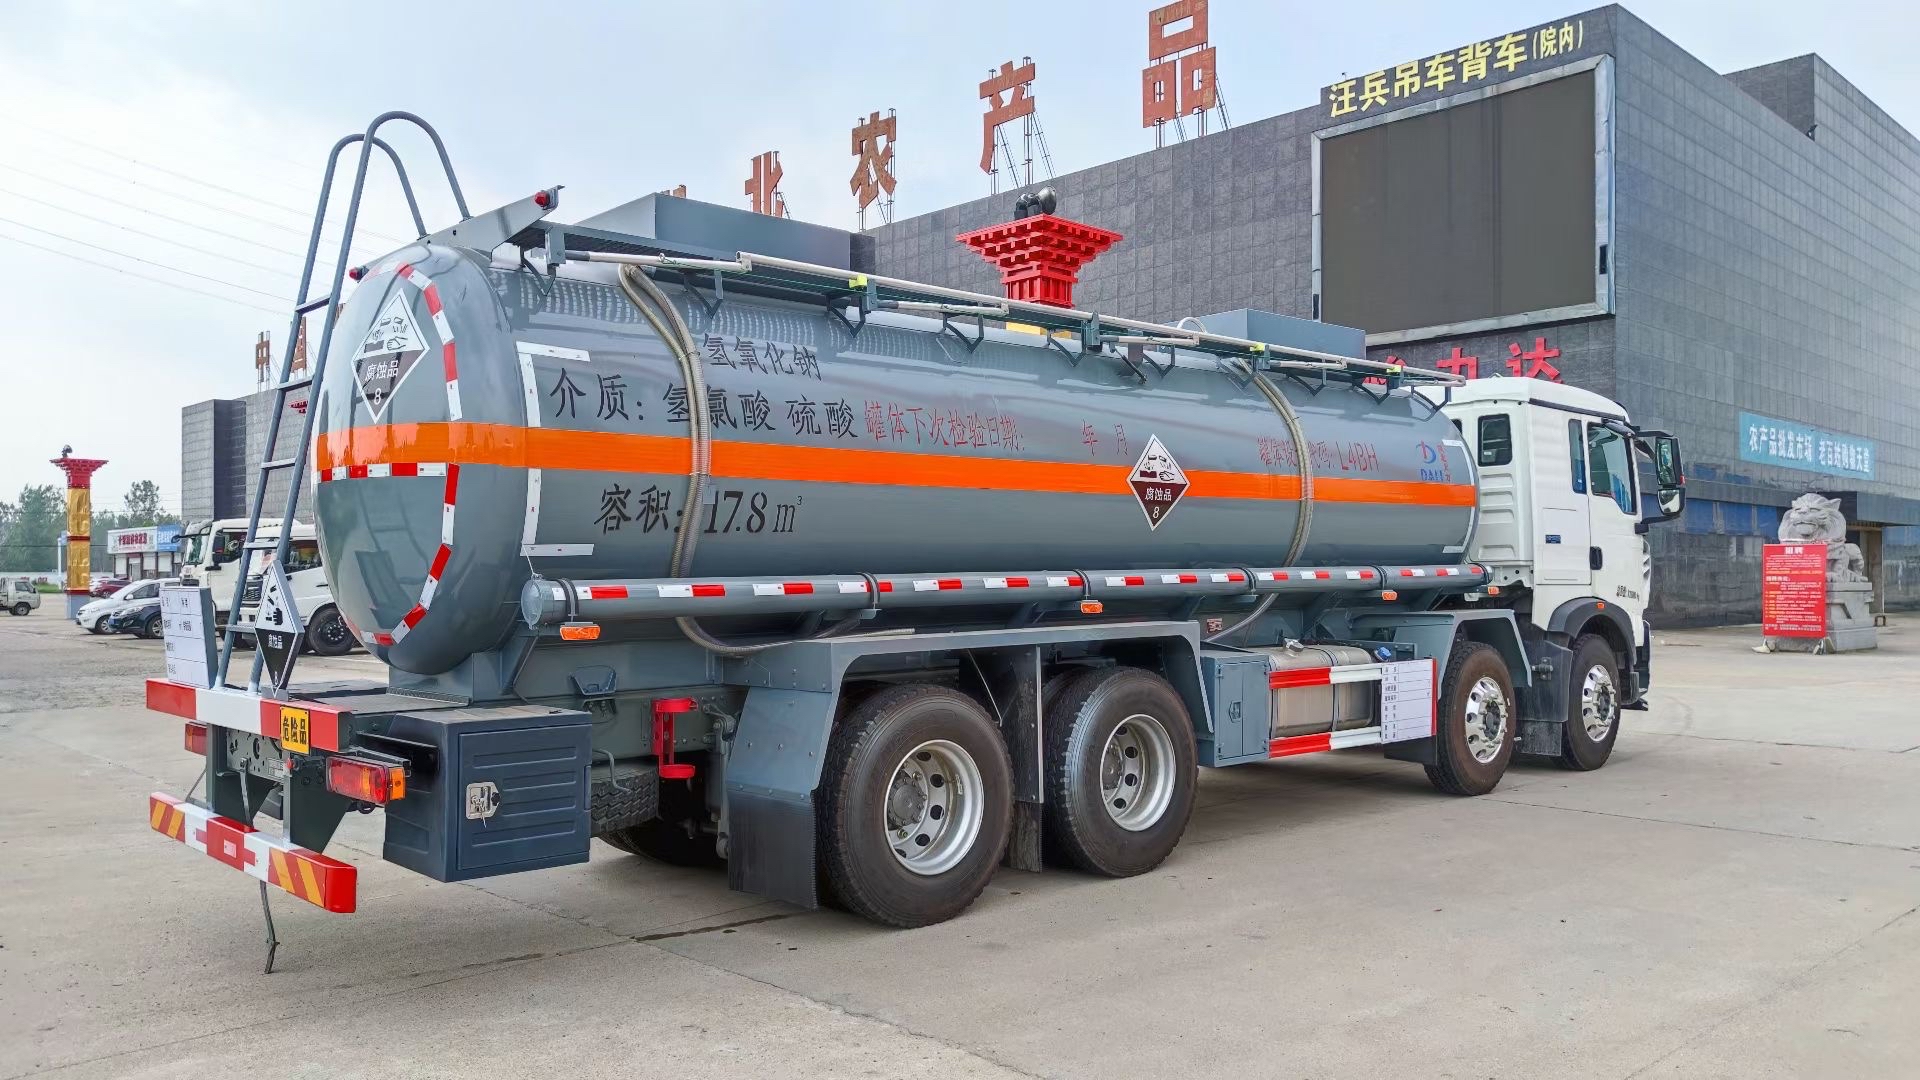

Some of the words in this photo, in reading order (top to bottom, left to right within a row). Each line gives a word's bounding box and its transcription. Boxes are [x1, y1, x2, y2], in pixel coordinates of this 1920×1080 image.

[703, 333, 822, 382] 氢氧化钠
[365, 360, 399, 381] 腐蚀品
[374, 388, 382, 405] 8
[1145, 487, 1172, 502] 腐蚀品
[1153, 506, 1160, 518] 8
[283, 716, 307, 745] 危险品
